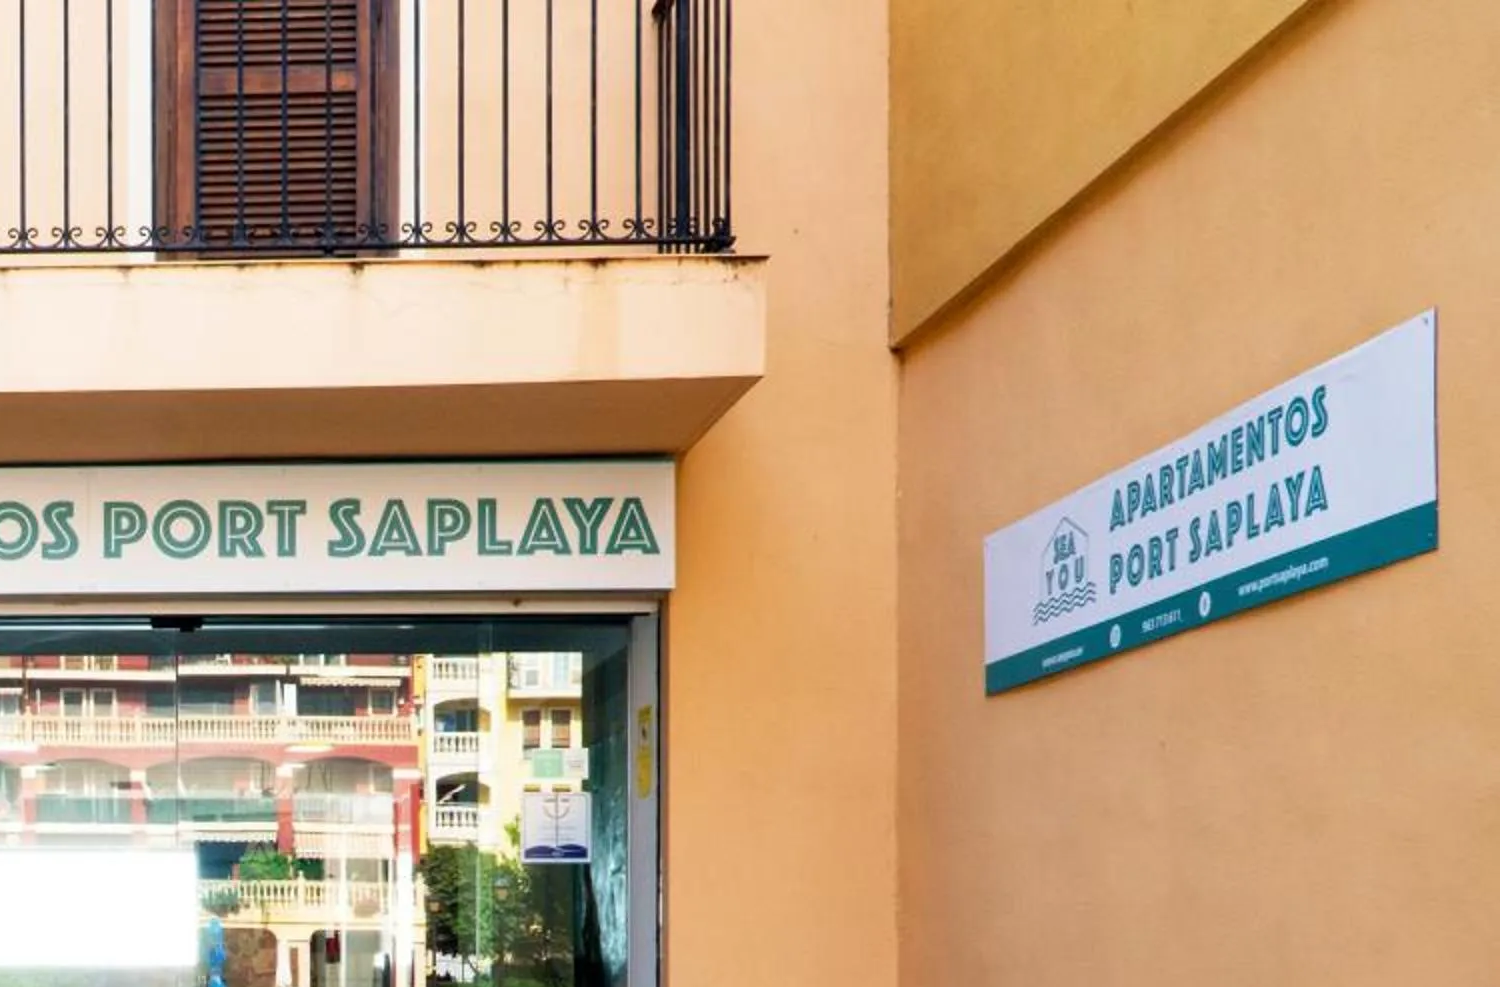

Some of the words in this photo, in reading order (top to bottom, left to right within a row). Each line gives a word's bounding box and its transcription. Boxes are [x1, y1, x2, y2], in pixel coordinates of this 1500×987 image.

[1109, 384, 1329, 533] APARTAMENTOS
[102, 499, 306, 560] PORT
[327, 497, 660, 558] SAPLAYA
[1054, 531, 1077, 564] SEA
[1109, 527, 1179, 595] PORT
[1189, 465, 1329, 564] SAPLAYA
[1046, 555, 1085, 596] YOU
